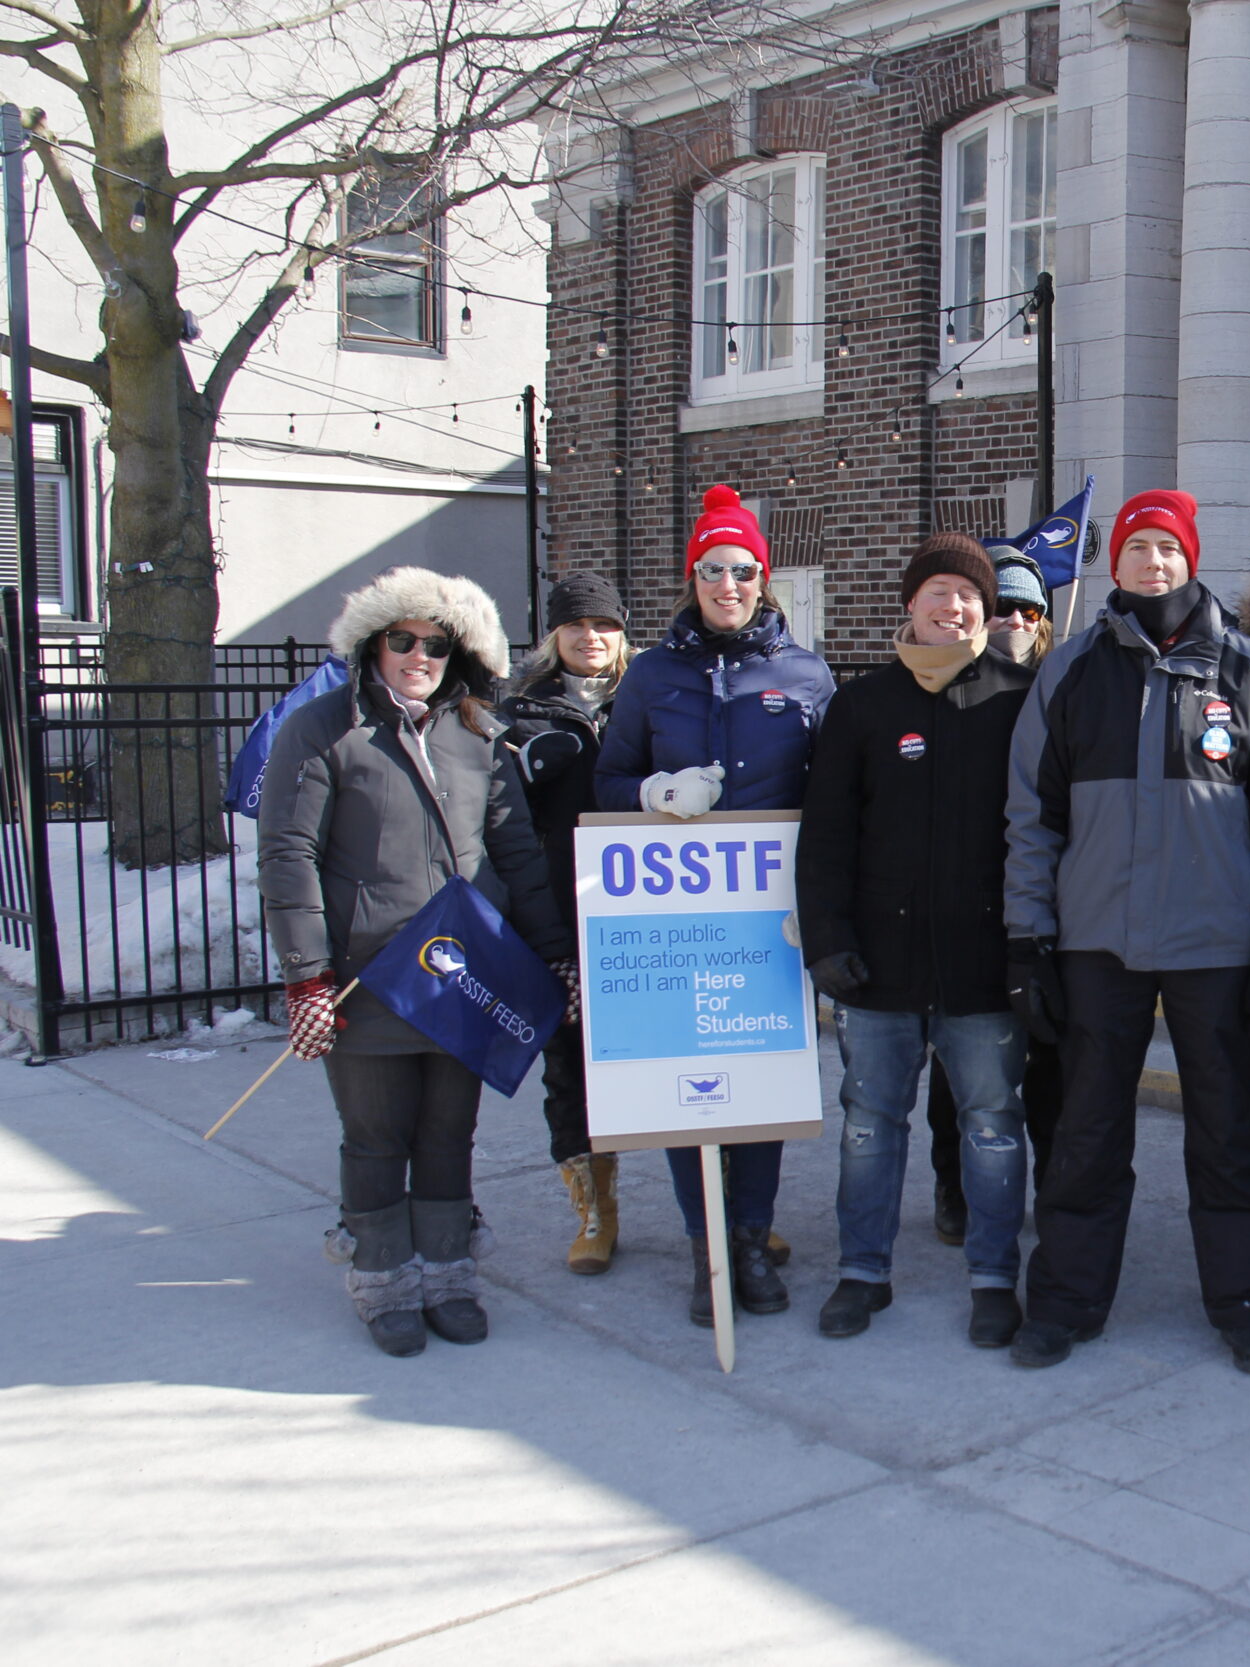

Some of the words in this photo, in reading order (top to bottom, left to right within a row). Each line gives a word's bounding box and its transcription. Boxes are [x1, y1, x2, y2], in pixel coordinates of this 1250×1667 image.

[602, 840, 783, 897] OSSTF
[600, 927, 604, 946] I
[611, 929, 642, 946] am
[649, 929, 662, 945] a
[668, 924, 726, 948] public
[600, 948, 698, 971] education
[705, 947, 771, 967] worker
[601, 972, 639, 994] and
[645, 973, 650, 991] I
[657, 975, 688, 991] am
[694, 970, 745, 990] Here
[695, 993, 730, 1012] For
[696, 1013, 793, 1034] Students.
